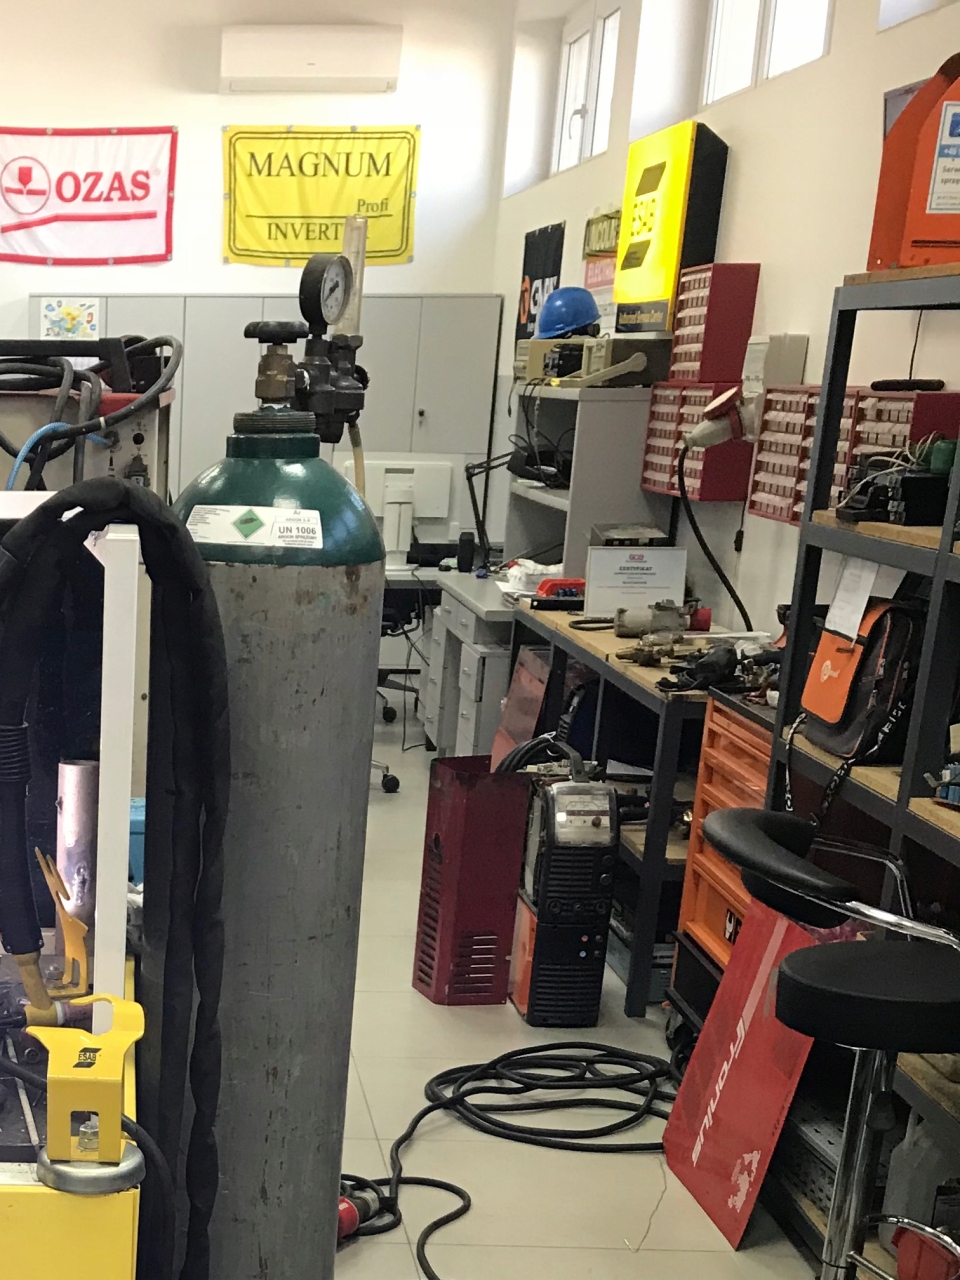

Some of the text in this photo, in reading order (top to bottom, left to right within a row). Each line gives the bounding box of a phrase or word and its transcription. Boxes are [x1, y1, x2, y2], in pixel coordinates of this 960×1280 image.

[247, 151, 392, 178] MAGNUM
[55, 170, 151, 203] OZAS
[357, 198, 389, 213] Profi
[278, 526, 316, 535] UN 1006
[78, 1053, 97, 1062] ESAB
[692, 1017, 746, 1167] Fronius
